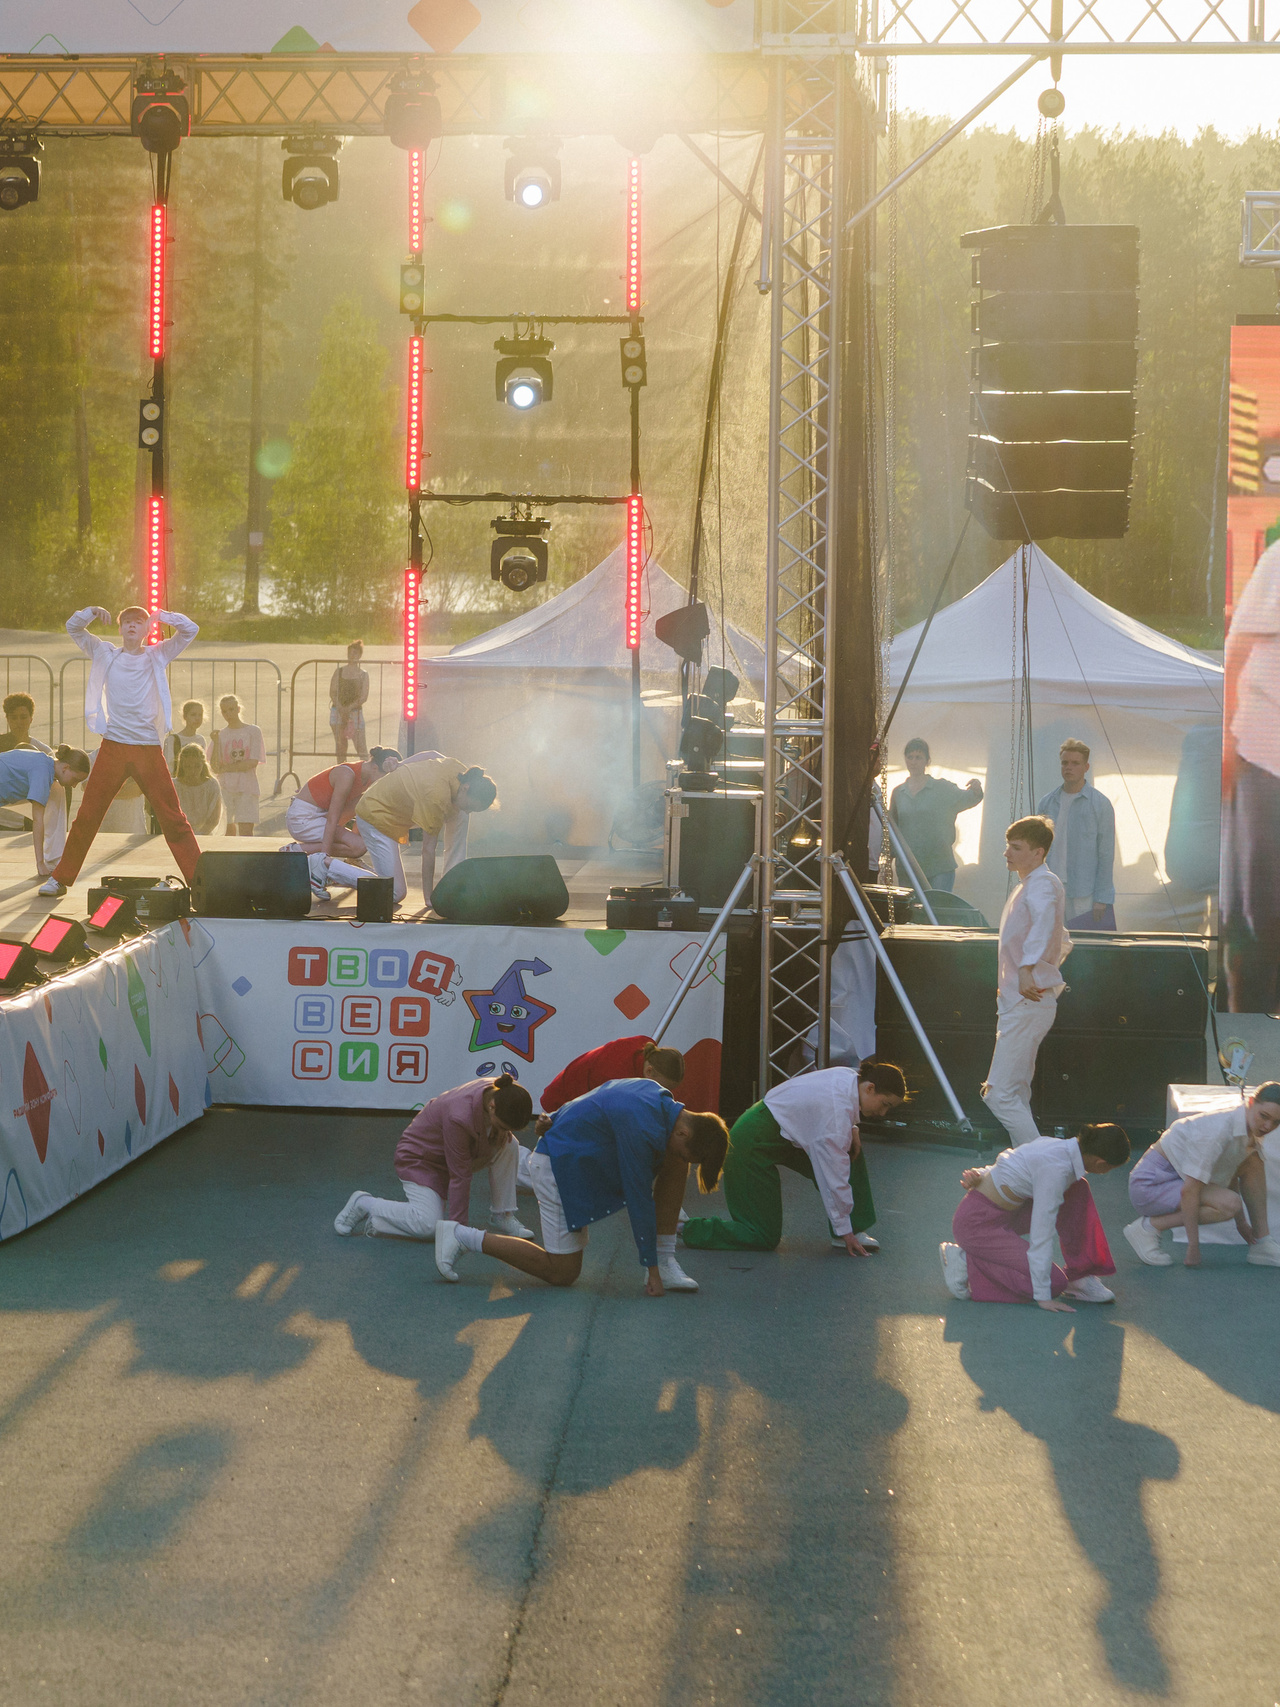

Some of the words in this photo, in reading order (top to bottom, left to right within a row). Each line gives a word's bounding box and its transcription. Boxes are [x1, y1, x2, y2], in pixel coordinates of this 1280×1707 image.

[295, 952, 448, 990] ТВОЯ
[301, 1000, 423, 1031] ВЕР
[299, 1046, 421, 1078] СИЯ
